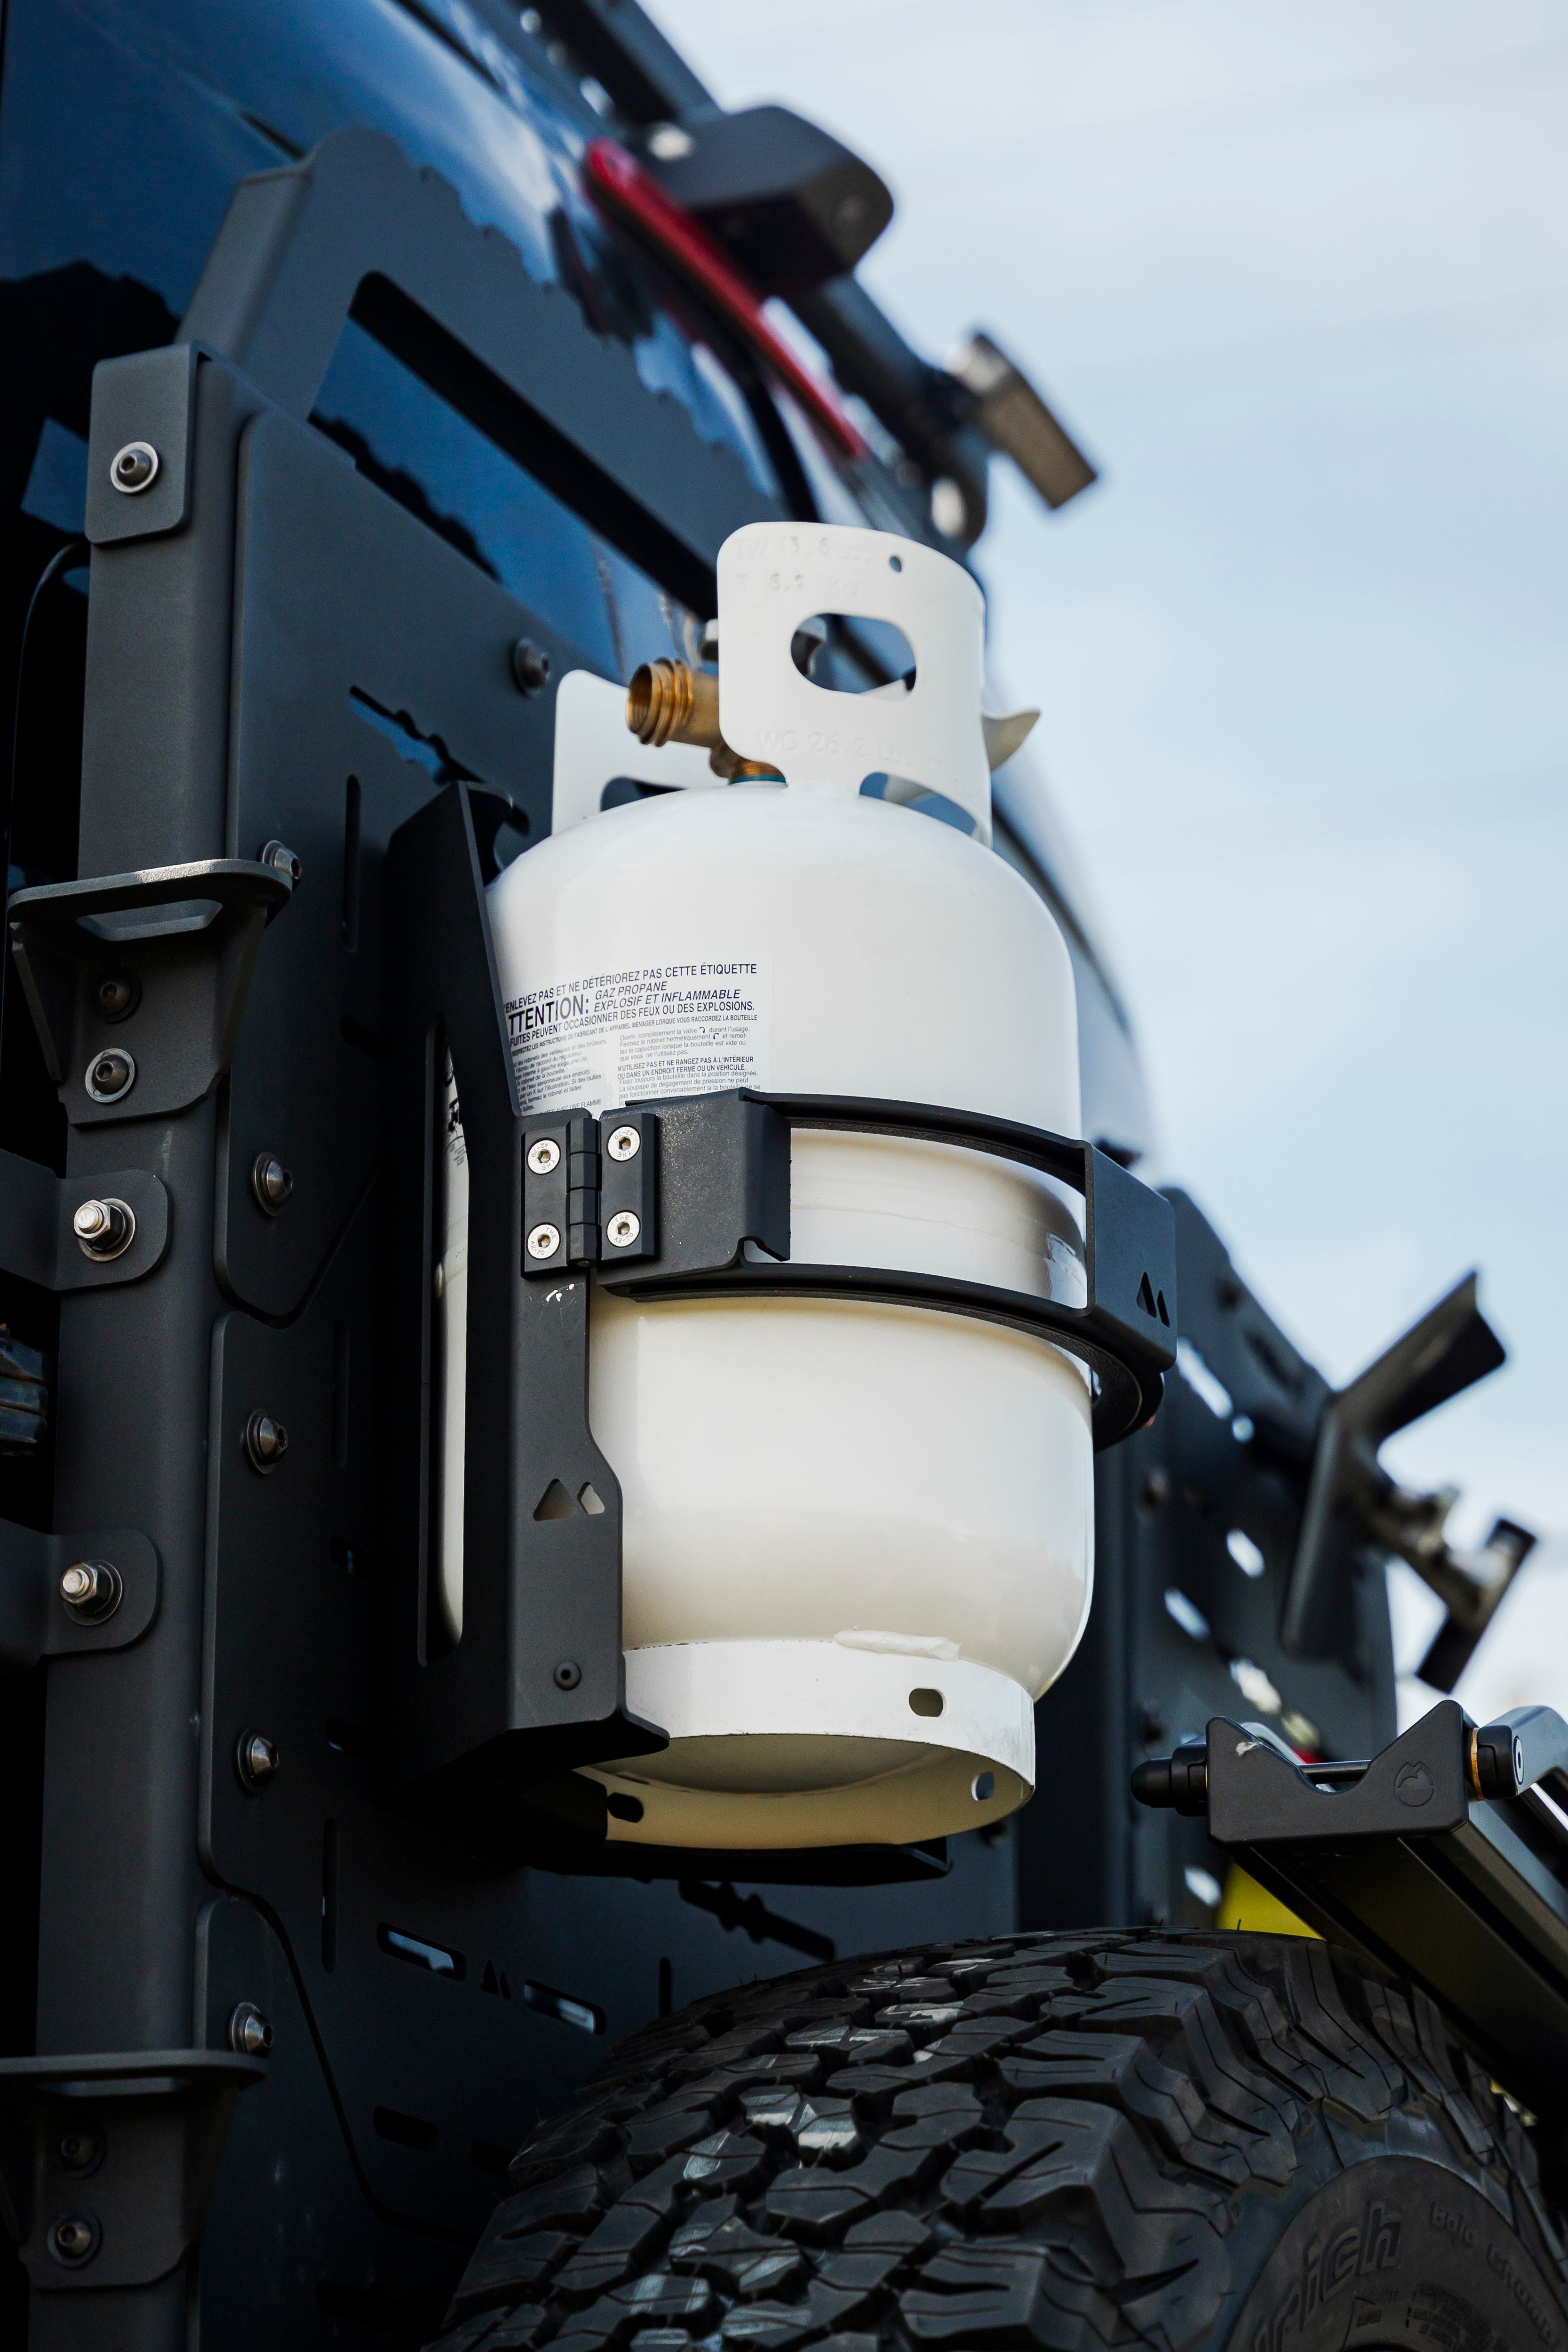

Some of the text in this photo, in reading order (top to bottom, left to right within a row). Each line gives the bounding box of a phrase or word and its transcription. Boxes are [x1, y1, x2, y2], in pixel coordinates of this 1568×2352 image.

[539, 988, 554, 1001] PAS
[556, 984, 566, 996] ET
[569, 981, 580, 993] NE
[583, 971, 640, 990] DÉTÉRIOREZ
[643, 969, 661, 980] PAS
[665, 965, 697, 977] CETTE
[700, 961, 756, 975] ÉTIQUETTE
[596, 981, 668, 1000] GAZ PROPANE
[594, 989, 740, 1012] EXPLOSIF ET INFLAMMABLE
[508, 994, 589, 1036] TTENTION:
[510, 1001, 755, 1048] FUITES PEUVENT OCCASIONNER DES FEUX OU DES EXPLOSIONS.
[539, 1035, 567, 1047] INSTRUCTIONS
[574, 1028, 597, 1039] FABRICANT
[632, 1020, 655, 1028] MÉNAGER
[638, 1029, 675, 1040] completement
[617, 1062, 645, 1072] N'UTILISEZ
[719, 1055, 754, 1063] L'INTÉRIEUR
[677, 1065, 695, 1073] FERMÉ
[634, 1075, 655, 1085] toujours
[731, 1070, 758, 1078] désignée.
[659, 1080, 692, 1088] dégagement
[548, 1089, 563, 1098] robinet
[629, 1089, 659, 1098] fonctionner
[661, 1086, 706, 1094] convenablement
[581, 1099, 602, 1108] FLAMME
[614, 1130, 634, 1140] A2-70
[531, 1143, 549, 1158] A2-70
[542, 1159, 555, 1170] THE
[546, 1227, 557, 1240] THE
[614, 1232, 634, 1243] A2-70
[531, 1240, 545, 1255] A2-70
